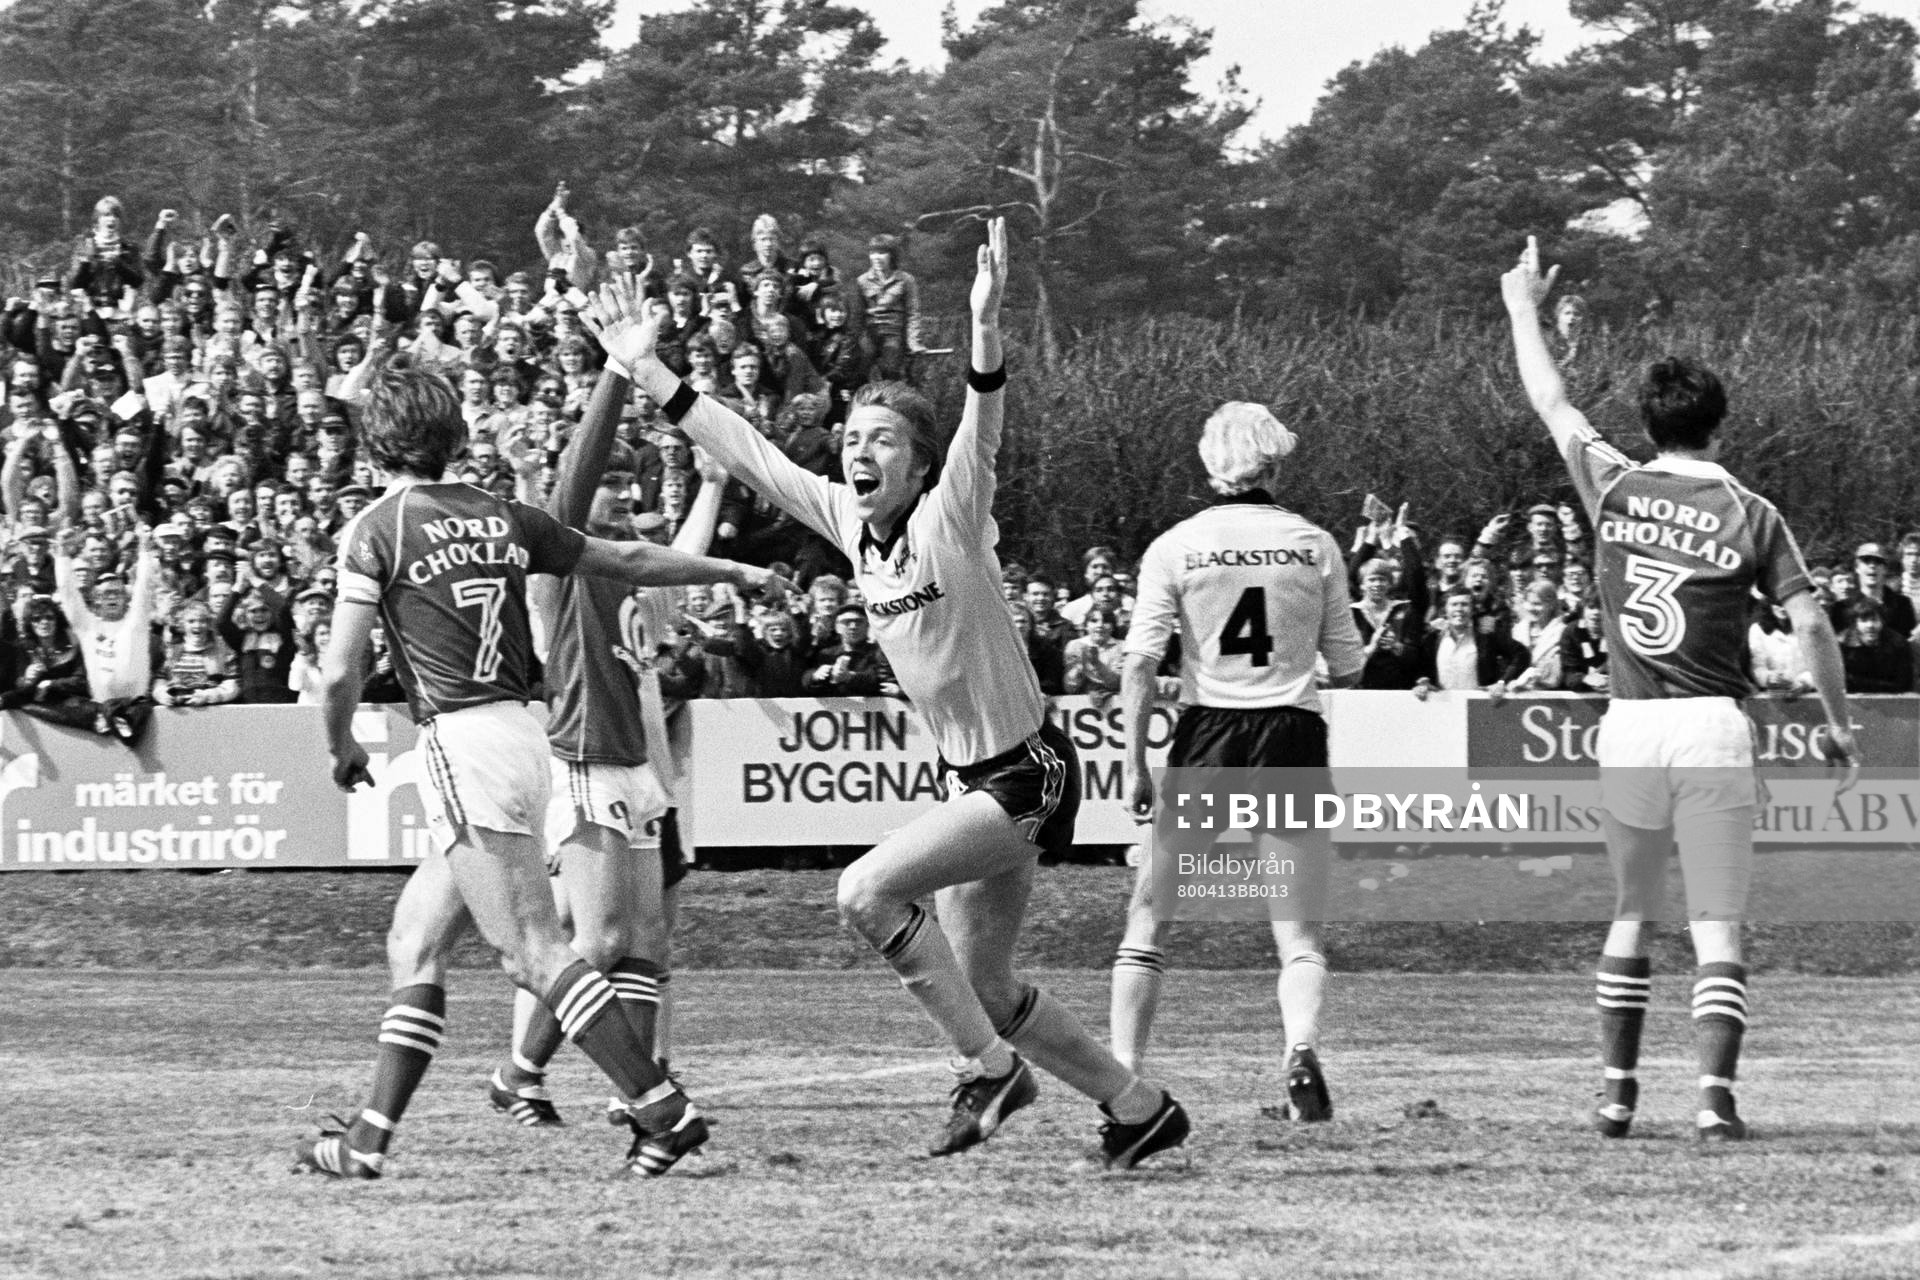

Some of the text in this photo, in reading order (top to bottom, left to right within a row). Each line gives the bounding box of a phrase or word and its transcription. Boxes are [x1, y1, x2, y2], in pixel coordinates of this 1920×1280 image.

[421, 516, 509, 544] NORD
[1627, 496, 1720, 532] NORD
[1185, 549, 1318, 570] BLACKSTONE
[1600, 521, 1742, 570] CHOKLAD
[870, 582, 945, 616] CKSTONE
[1619, 553, 1696, 655] 3
[450, 577, 508, 683] 7
[1219, 586, 1274, 667] 4
[780, 710, 907, 752] JOHN
[75, 772, 284, 807] märket för
[1489, 793, 1602, 832] Ohlss
[1822, 792, 1888, 832] AB
[17, 814, 287, 863] industrirör
